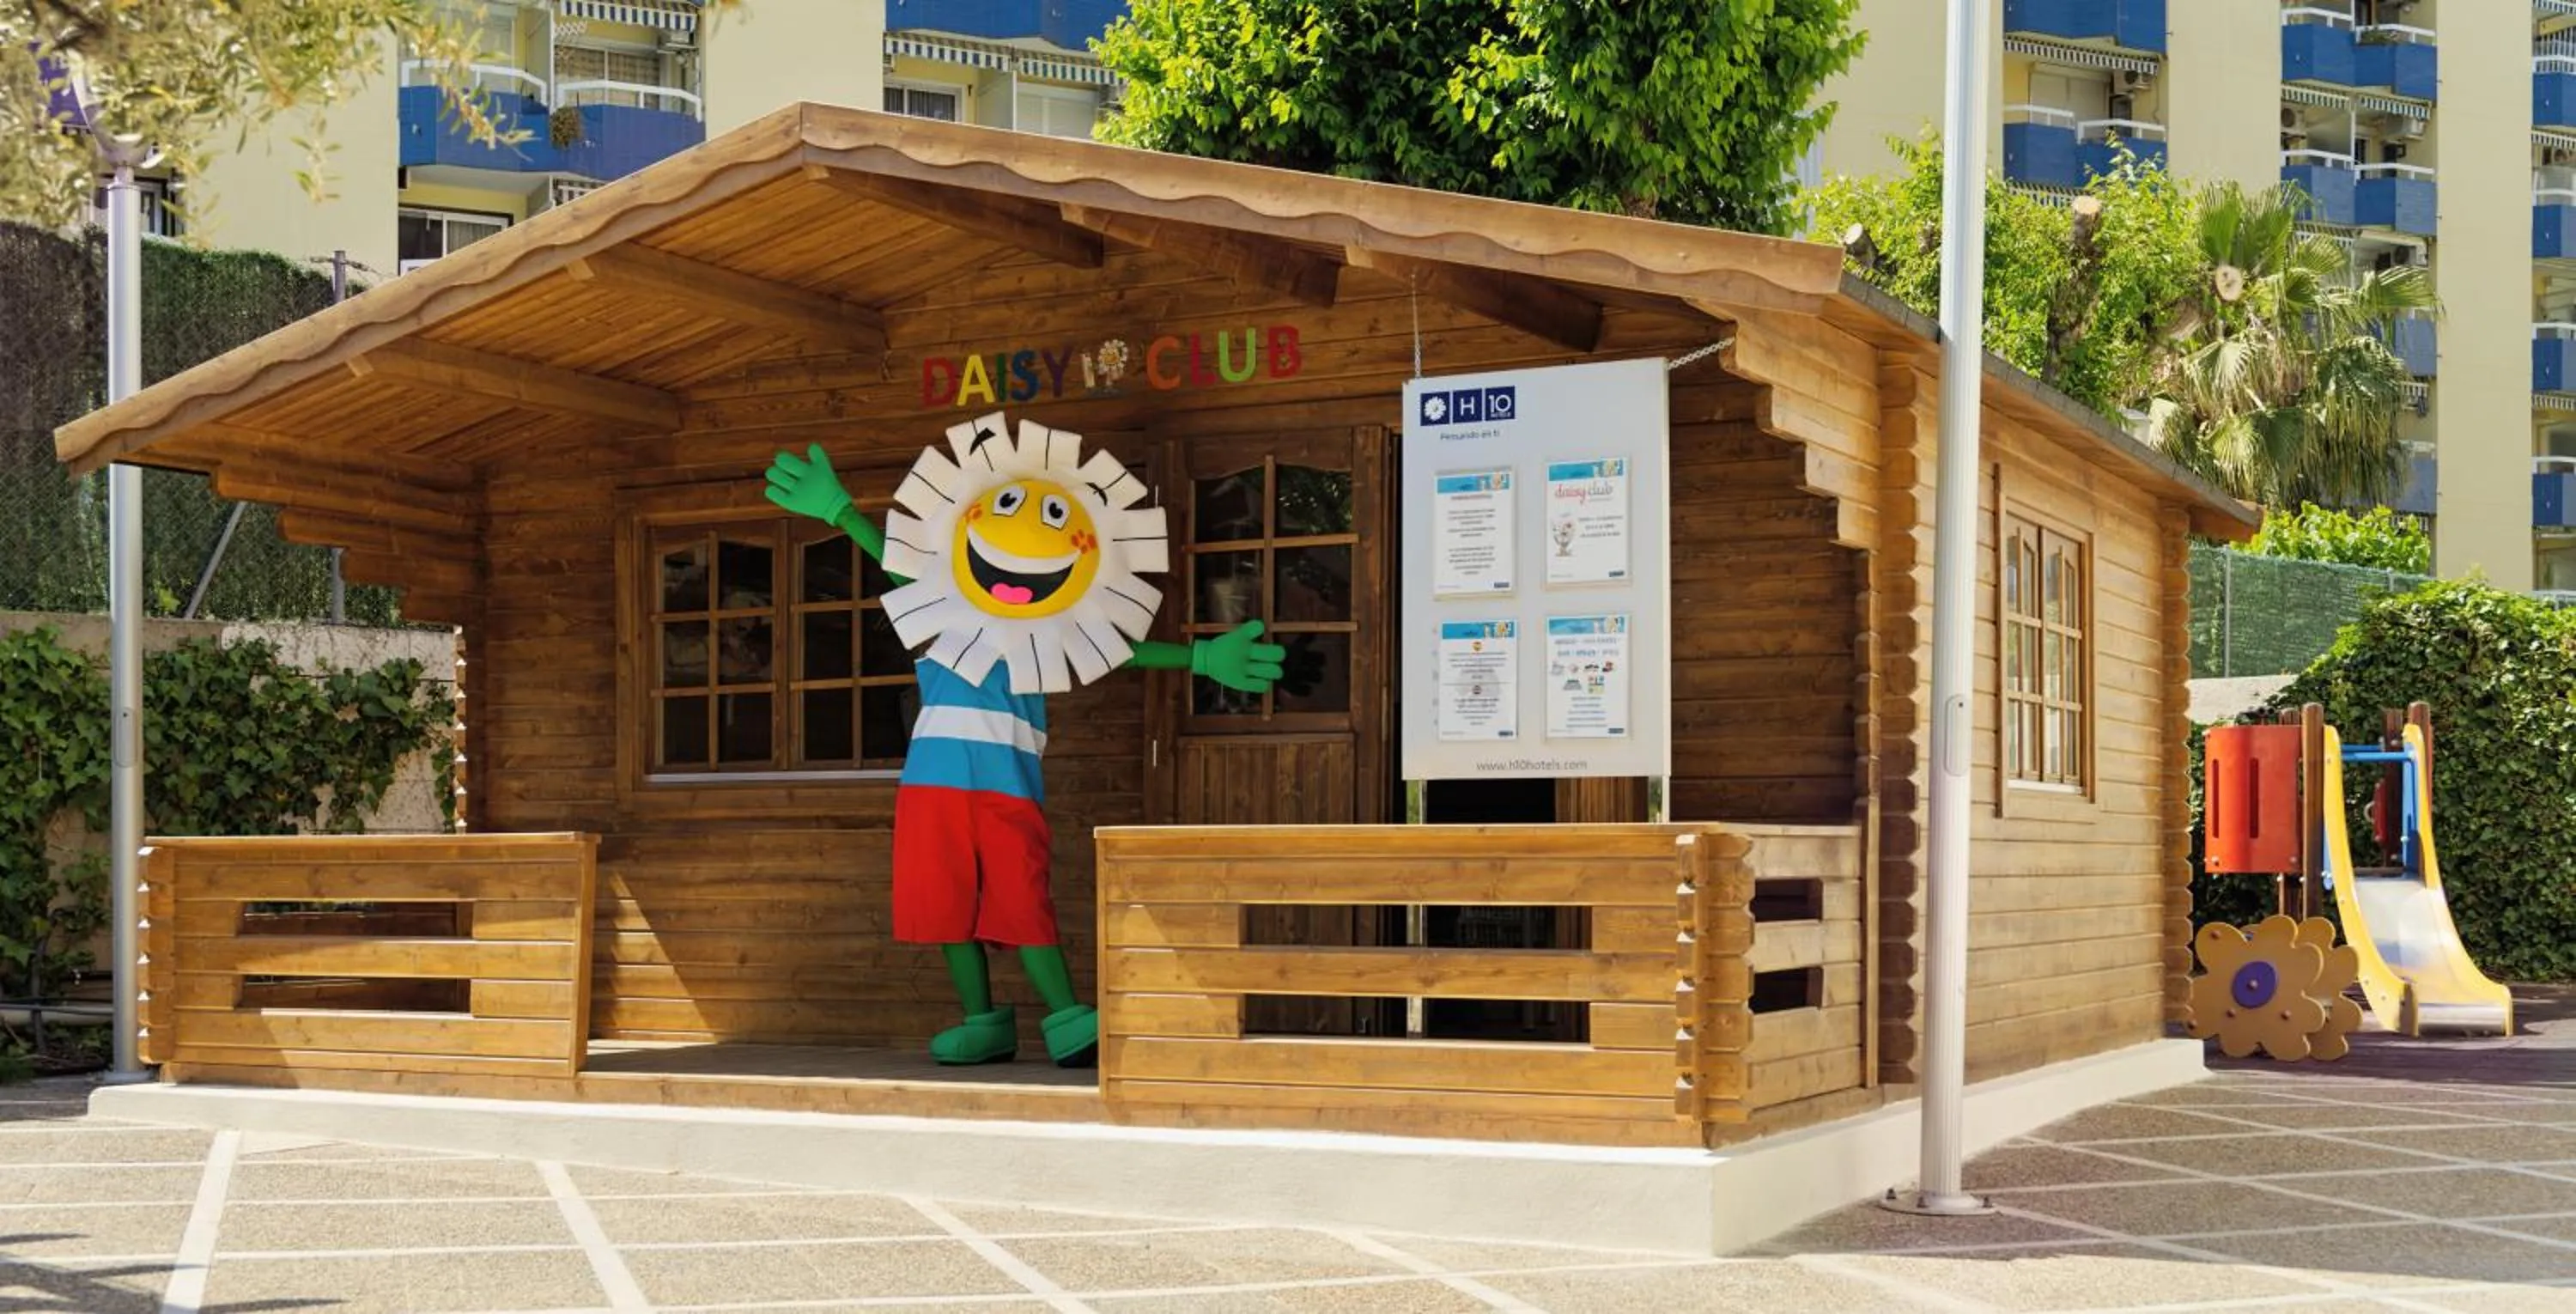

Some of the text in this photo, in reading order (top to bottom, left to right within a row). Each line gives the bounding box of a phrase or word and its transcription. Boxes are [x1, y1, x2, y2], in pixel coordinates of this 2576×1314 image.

[921, 325, 1302, 406] DAISY CLUB
[1461, 394, 1511, 416] H 10
[1476, 758, 1588, 770] www.h10hotels.com
